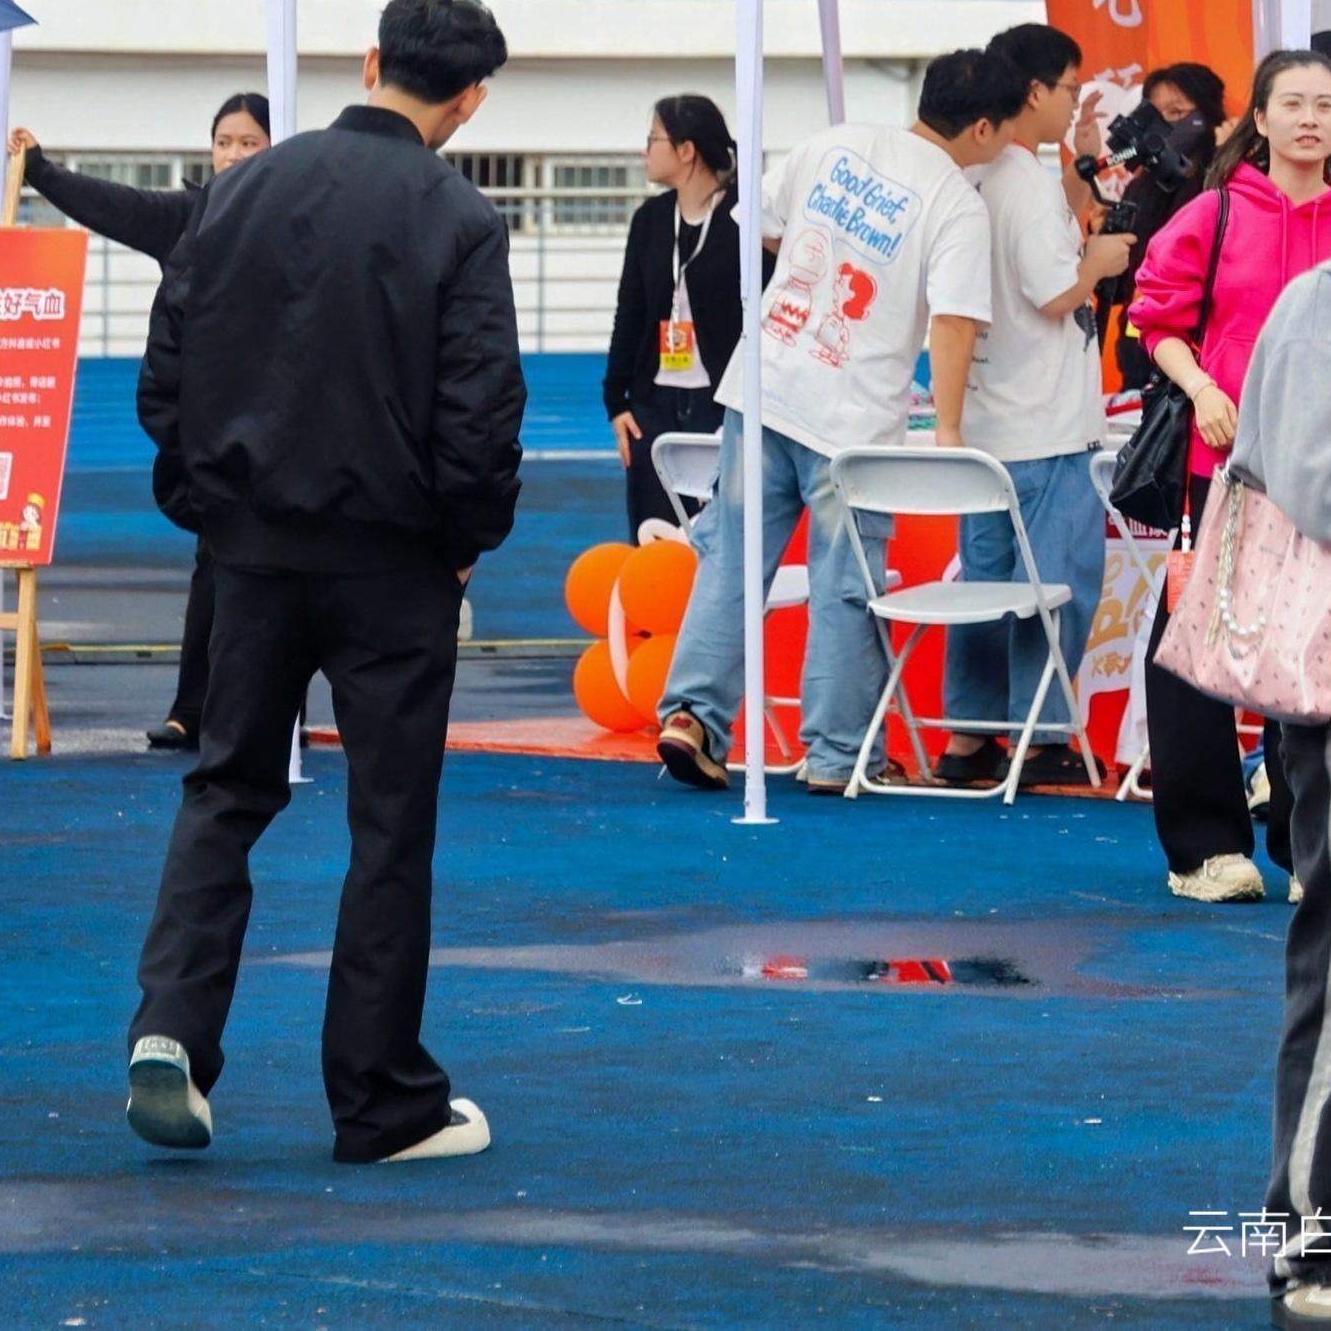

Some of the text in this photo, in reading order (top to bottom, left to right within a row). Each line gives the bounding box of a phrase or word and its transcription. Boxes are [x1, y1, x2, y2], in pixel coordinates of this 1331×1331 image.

[830, 156, 874, 197] Good
[808, 182, 903, 258] Charlie Brown!
